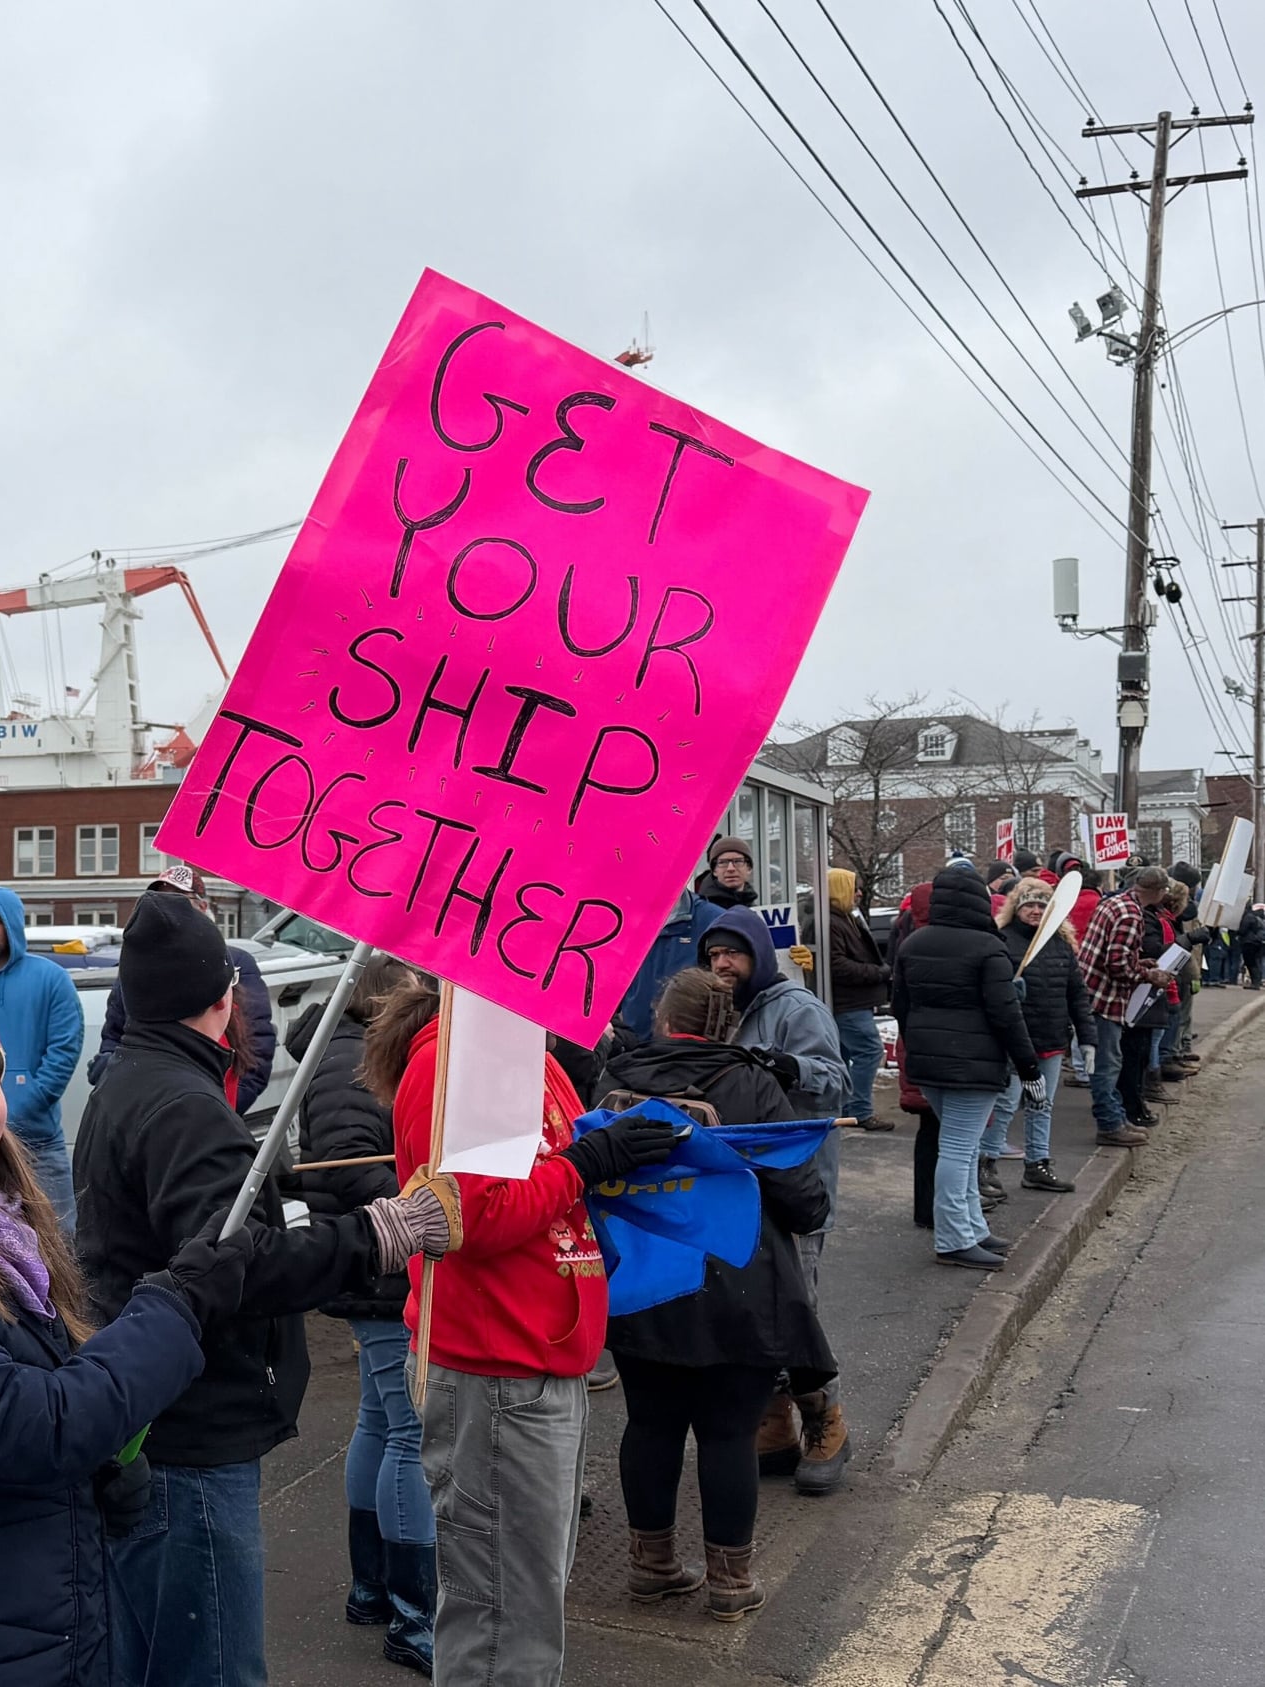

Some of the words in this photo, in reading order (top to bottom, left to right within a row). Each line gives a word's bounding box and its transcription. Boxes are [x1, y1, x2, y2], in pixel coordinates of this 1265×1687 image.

[430, 321, 734, 544] GET
[390, 458, 713, 716] YOUR
[328, 627, 660, 826] SHIP
[1096, 816, 1125, 828] UAW
[196, 710, 623, 1017] TOGETHER
[1104, 832, 1117, 846] ON
